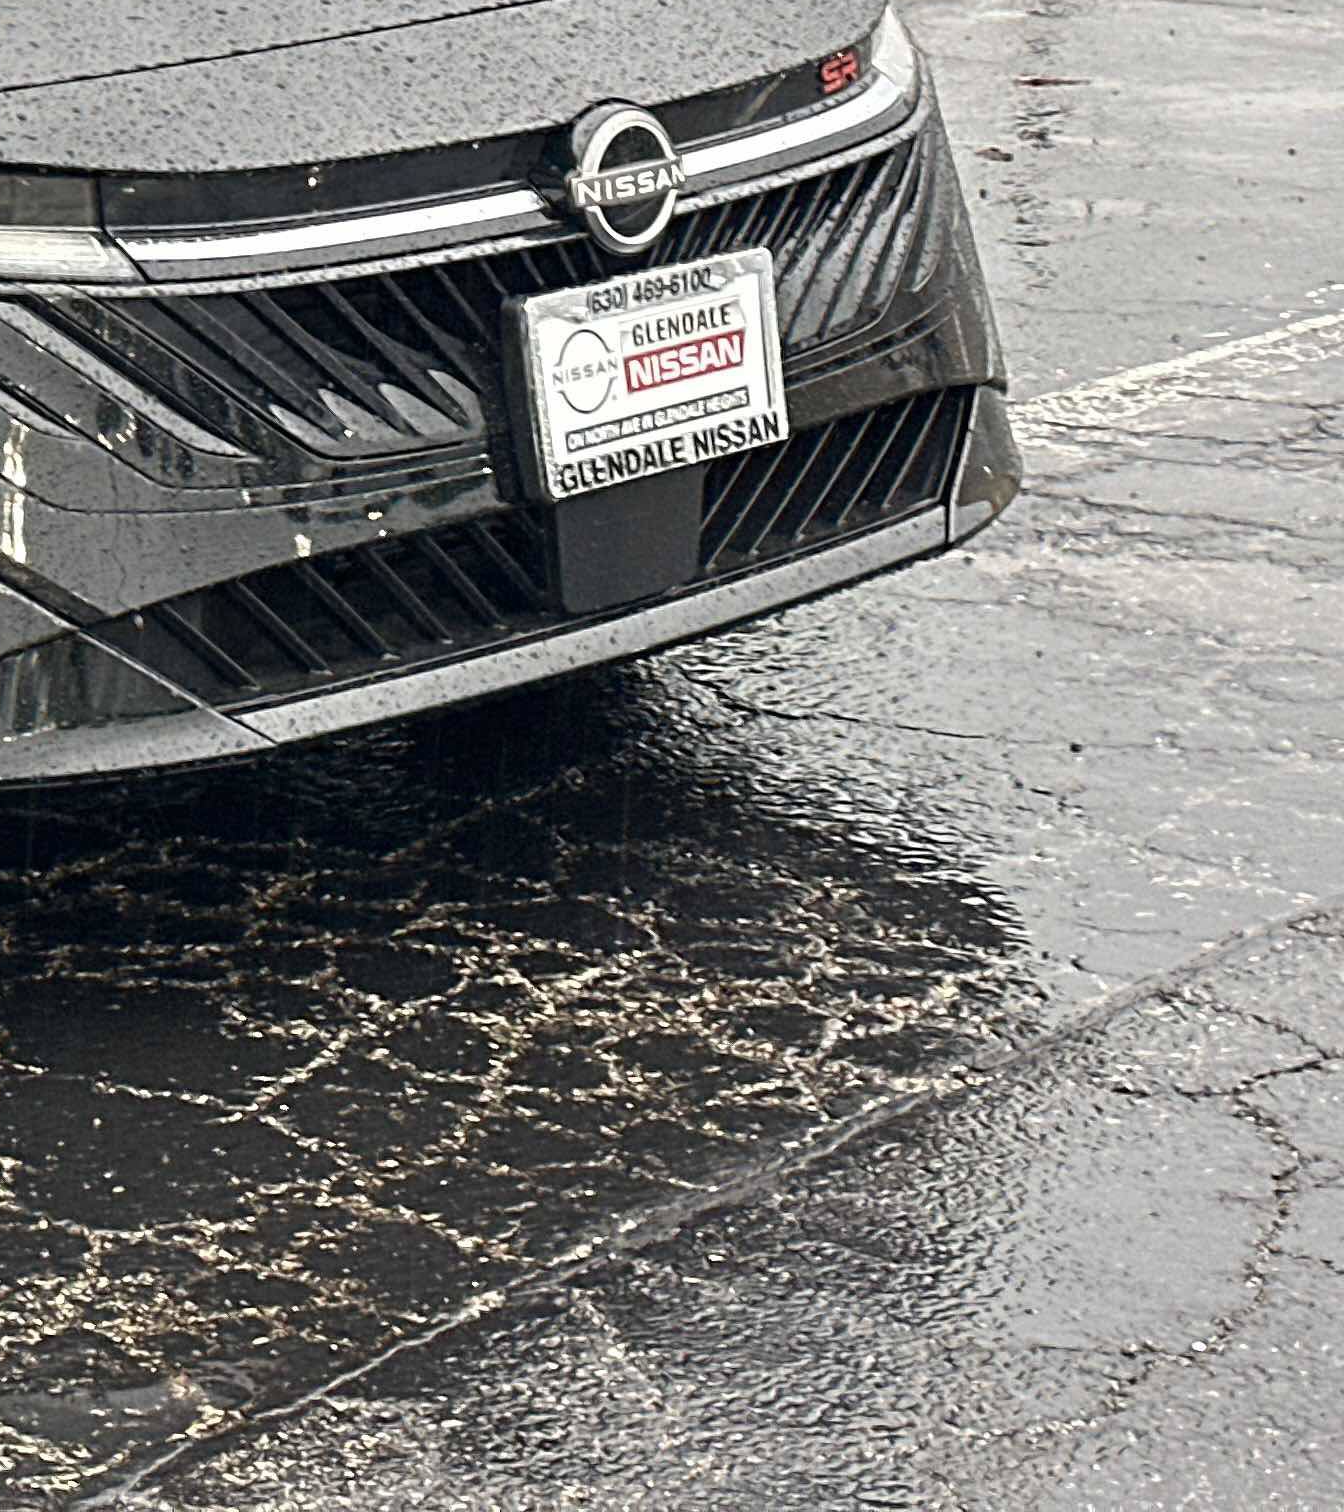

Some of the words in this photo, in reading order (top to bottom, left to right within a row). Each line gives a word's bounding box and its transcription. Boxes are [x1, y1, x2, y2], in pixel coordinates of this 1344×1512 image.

[576, 164, 686, 205] NISSAN
[632, 303, 731, 346] GLENDALE
[552, 356, 618, 386] NISSAN
[628, 335, 741, 389] NISSAN
[560, 436, 687, 491] GLENDALE
[692, 412, 780, 459] NISSAN
